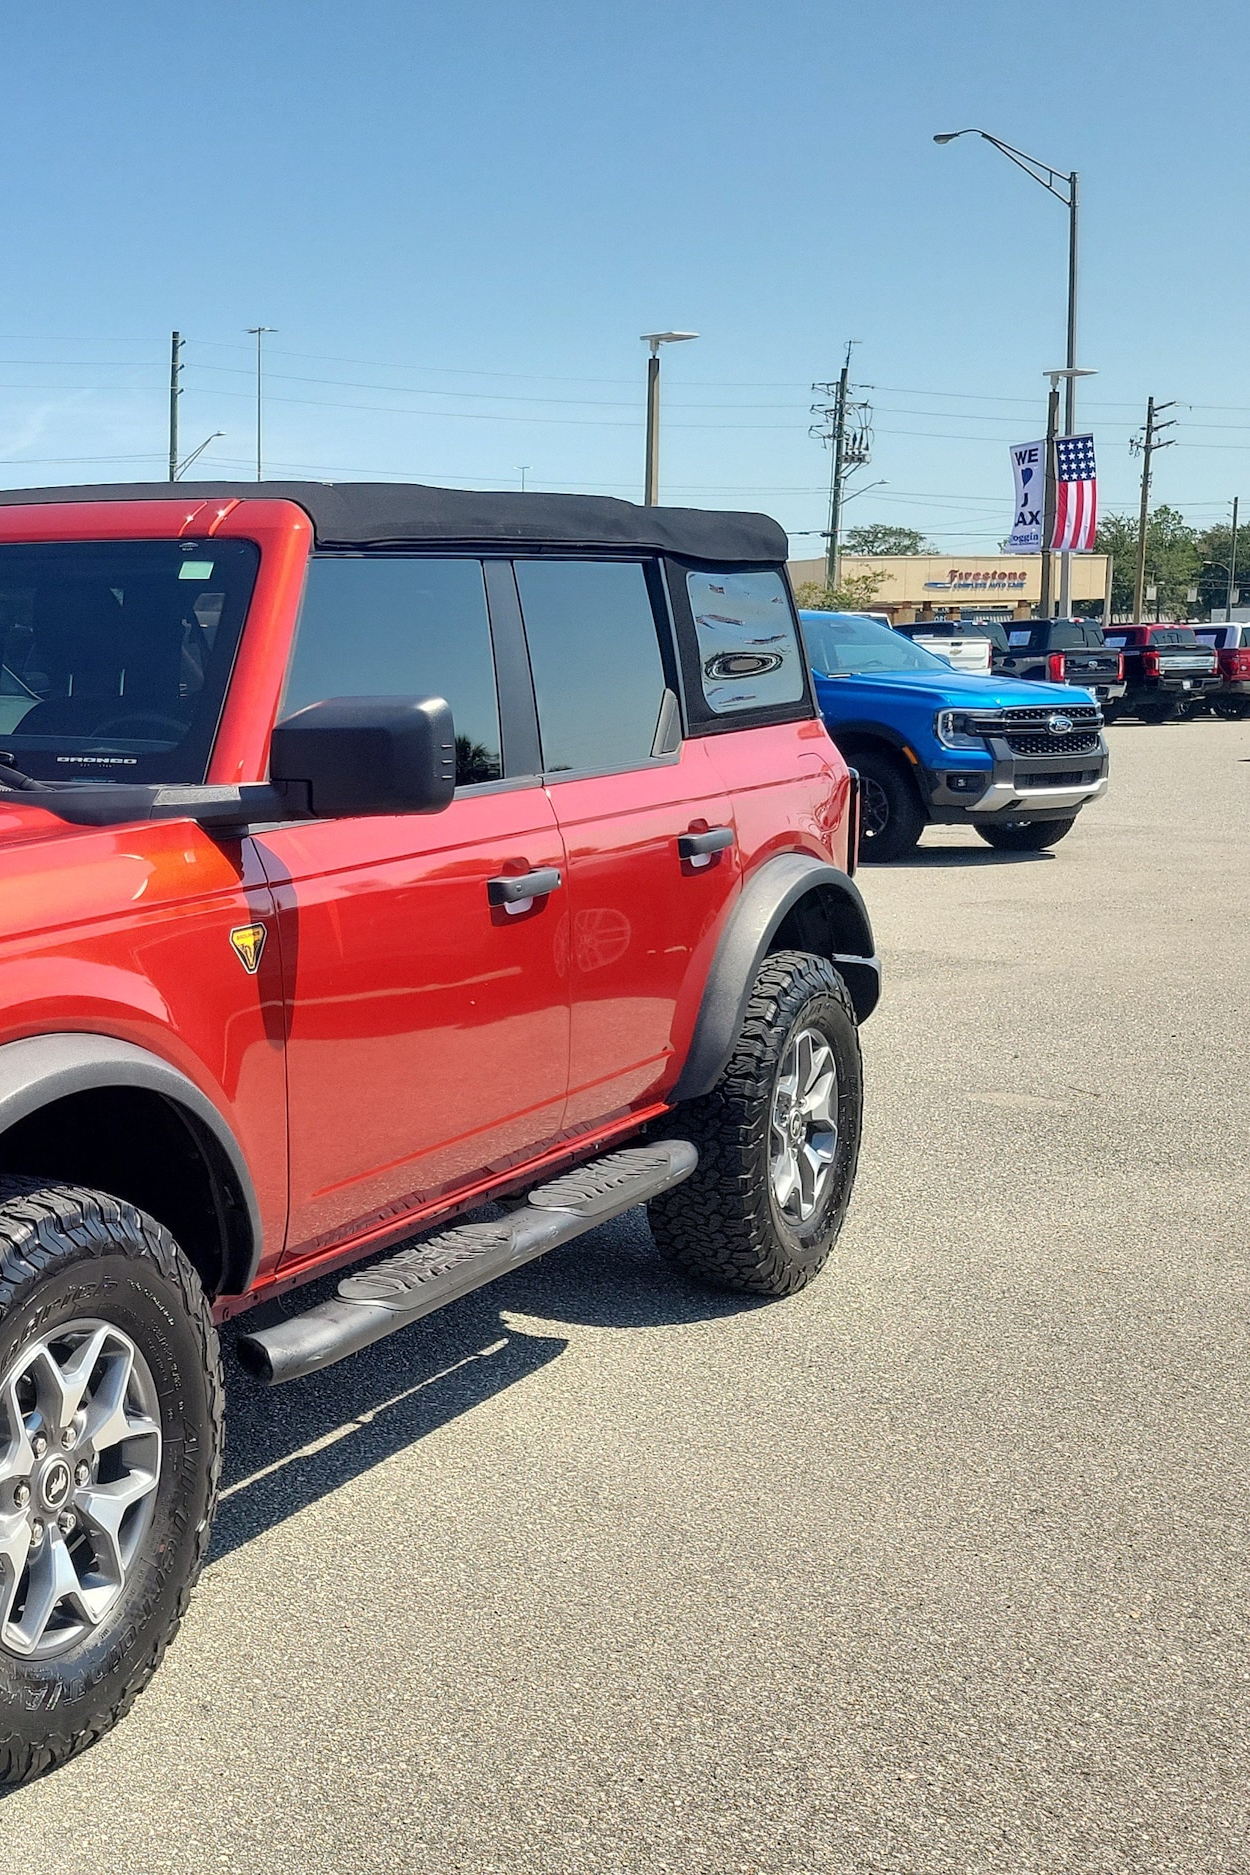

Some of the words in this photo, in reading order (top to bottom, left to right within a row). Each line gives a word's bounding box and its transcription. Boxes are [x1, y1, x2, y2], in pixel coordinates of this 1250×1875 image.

[1014, 448, 1039, 466] WE
[1012, 532, 1039, 544] oggin
[947, 569, 1027, 584] Firestone
[57, 756, 137, 764] BRONCO
